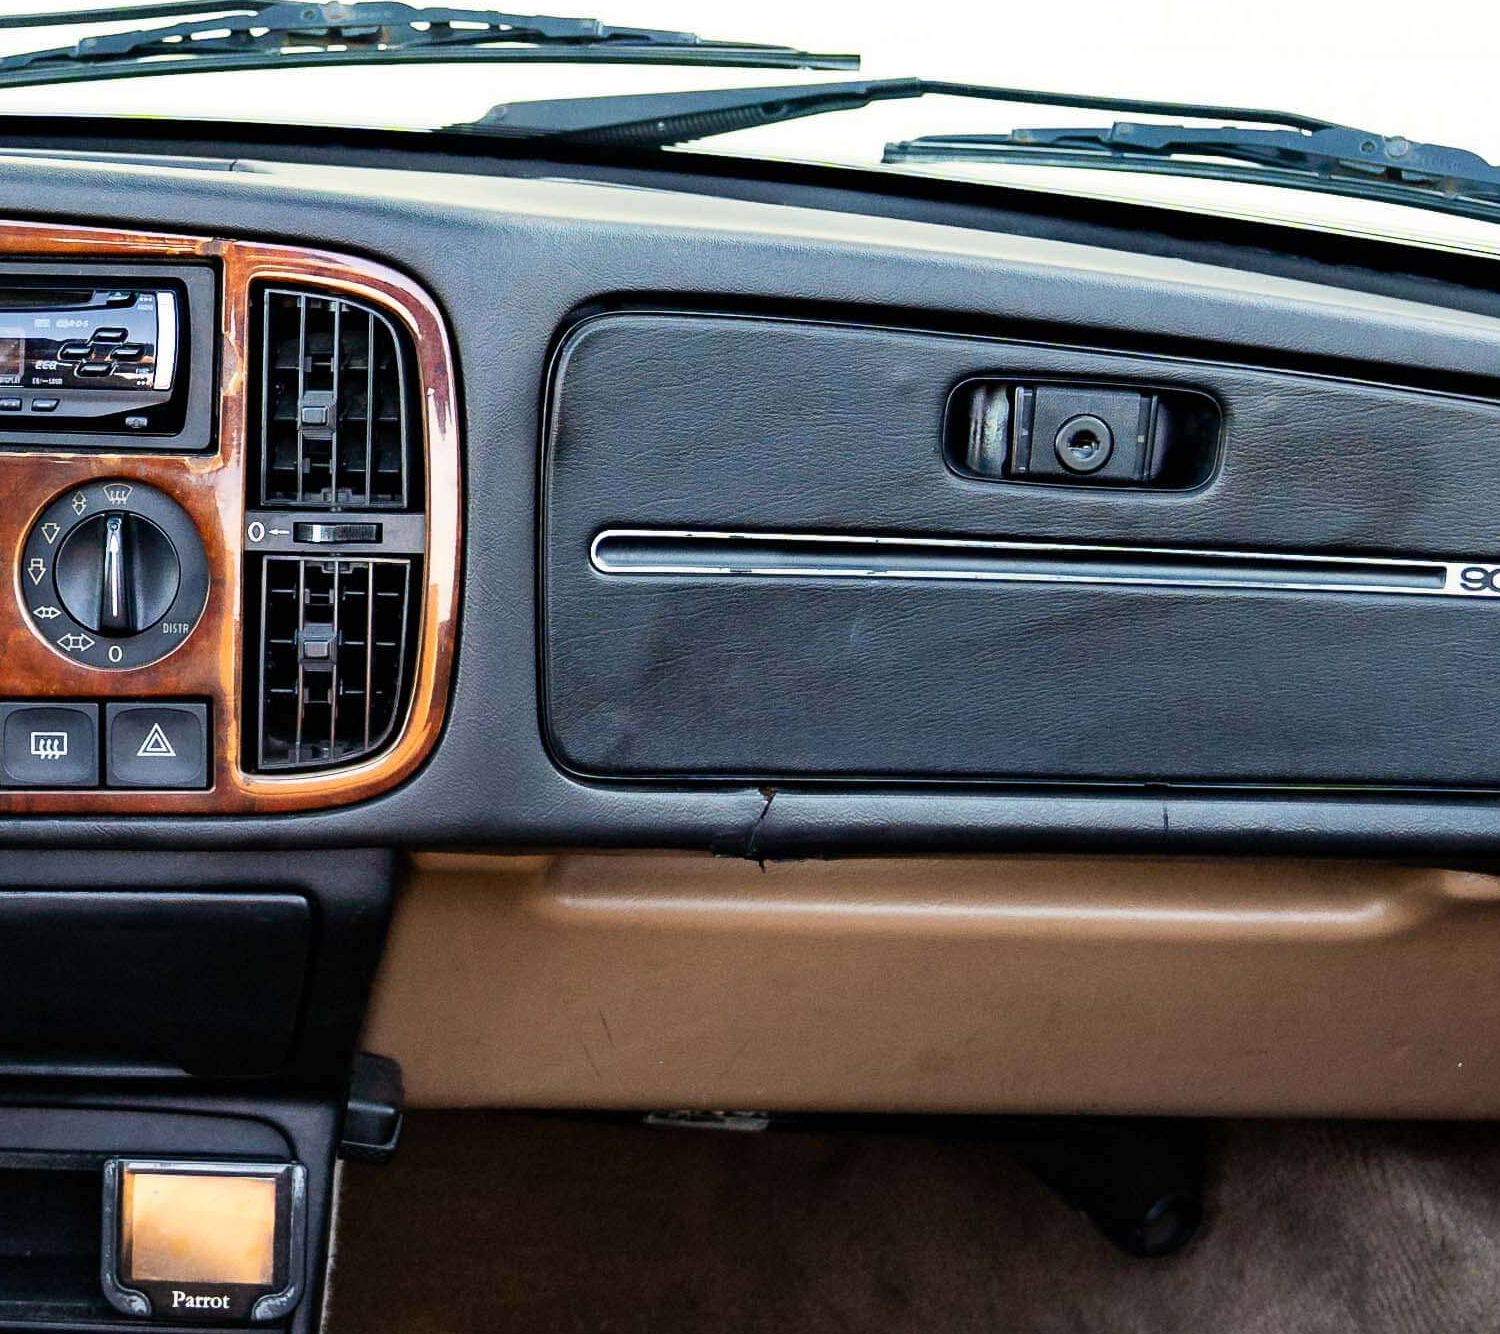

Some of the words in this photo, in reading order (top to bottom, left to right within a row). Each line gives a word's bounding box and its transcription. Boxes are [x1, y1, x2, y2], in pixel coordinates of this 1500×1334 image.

[162, 622, 189, 634] DISTR
[107, 645, 123, 663] 0
[171, 1290, 231, 1310] Parrot
